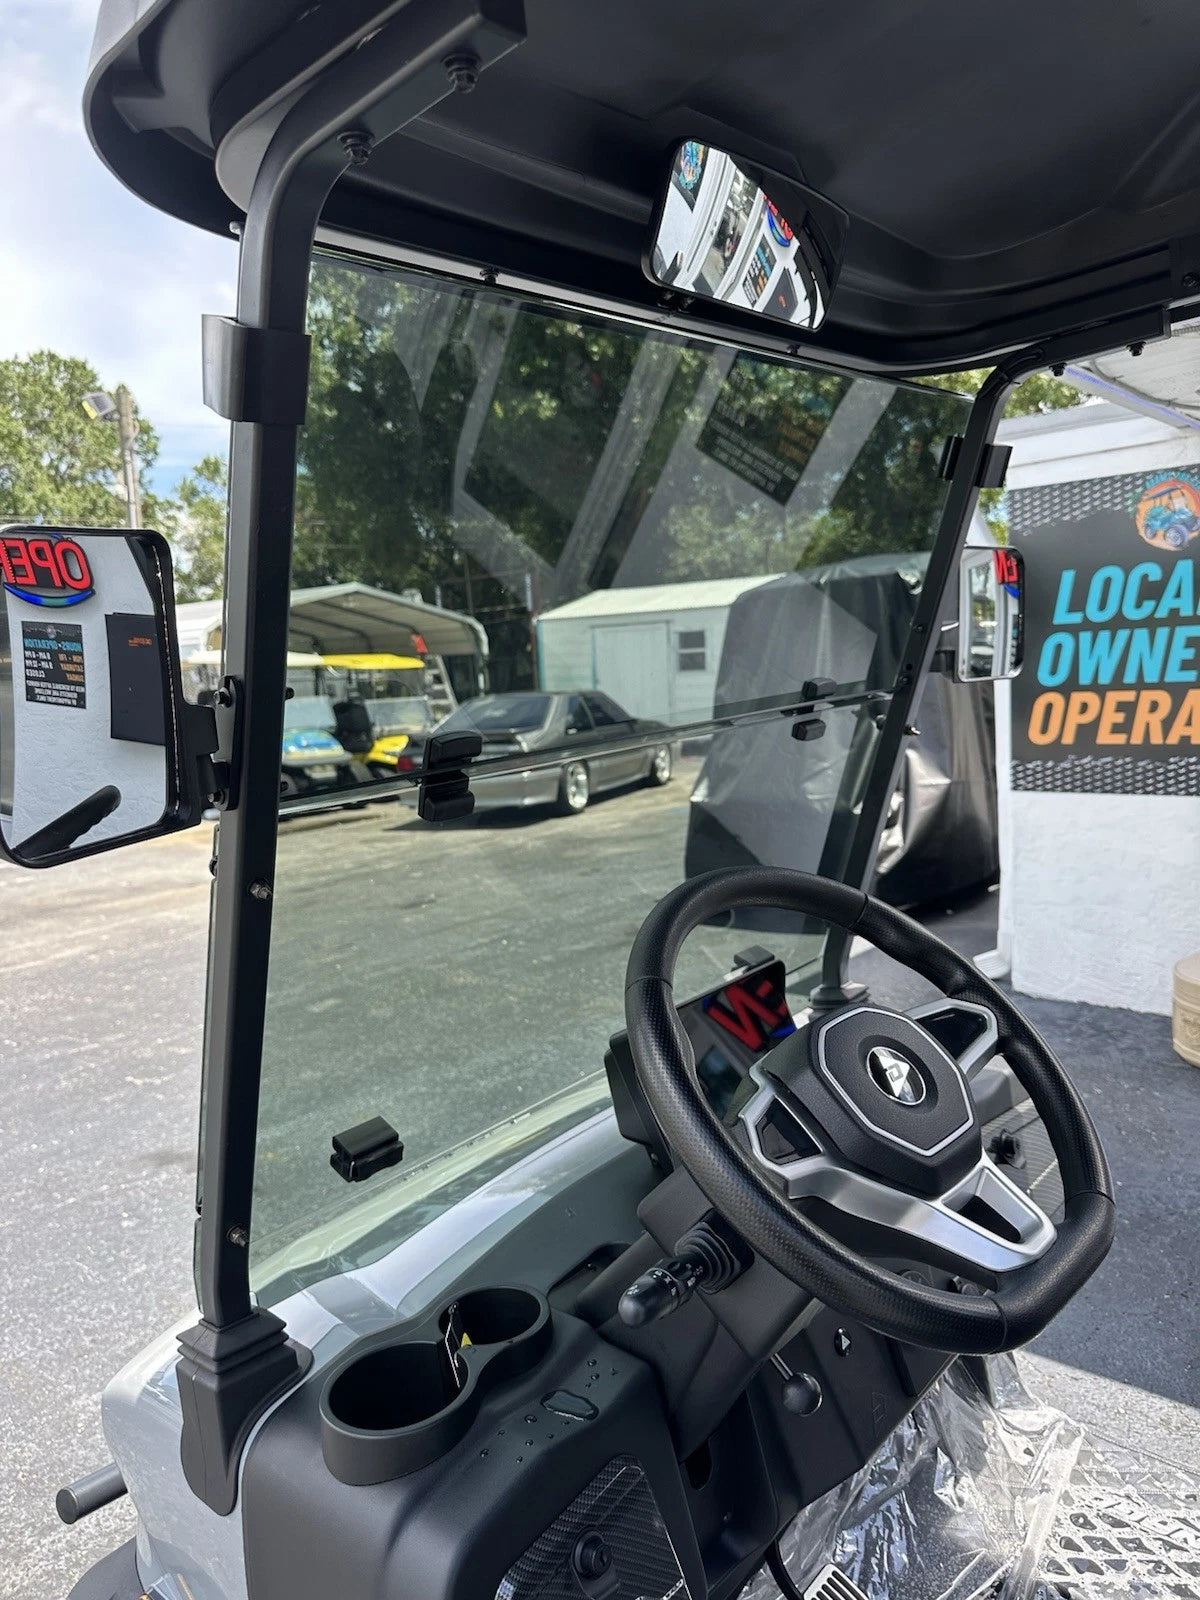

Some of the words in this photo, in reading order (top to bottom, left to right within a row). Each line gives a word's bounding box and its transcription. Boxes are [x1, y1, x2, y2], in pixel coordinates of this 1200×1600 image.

[1053, 559, 1200, 625] LOCA
[1036, 625, 1200, 688] OWNE
[1027, 688, 1200, 745] OPERA
